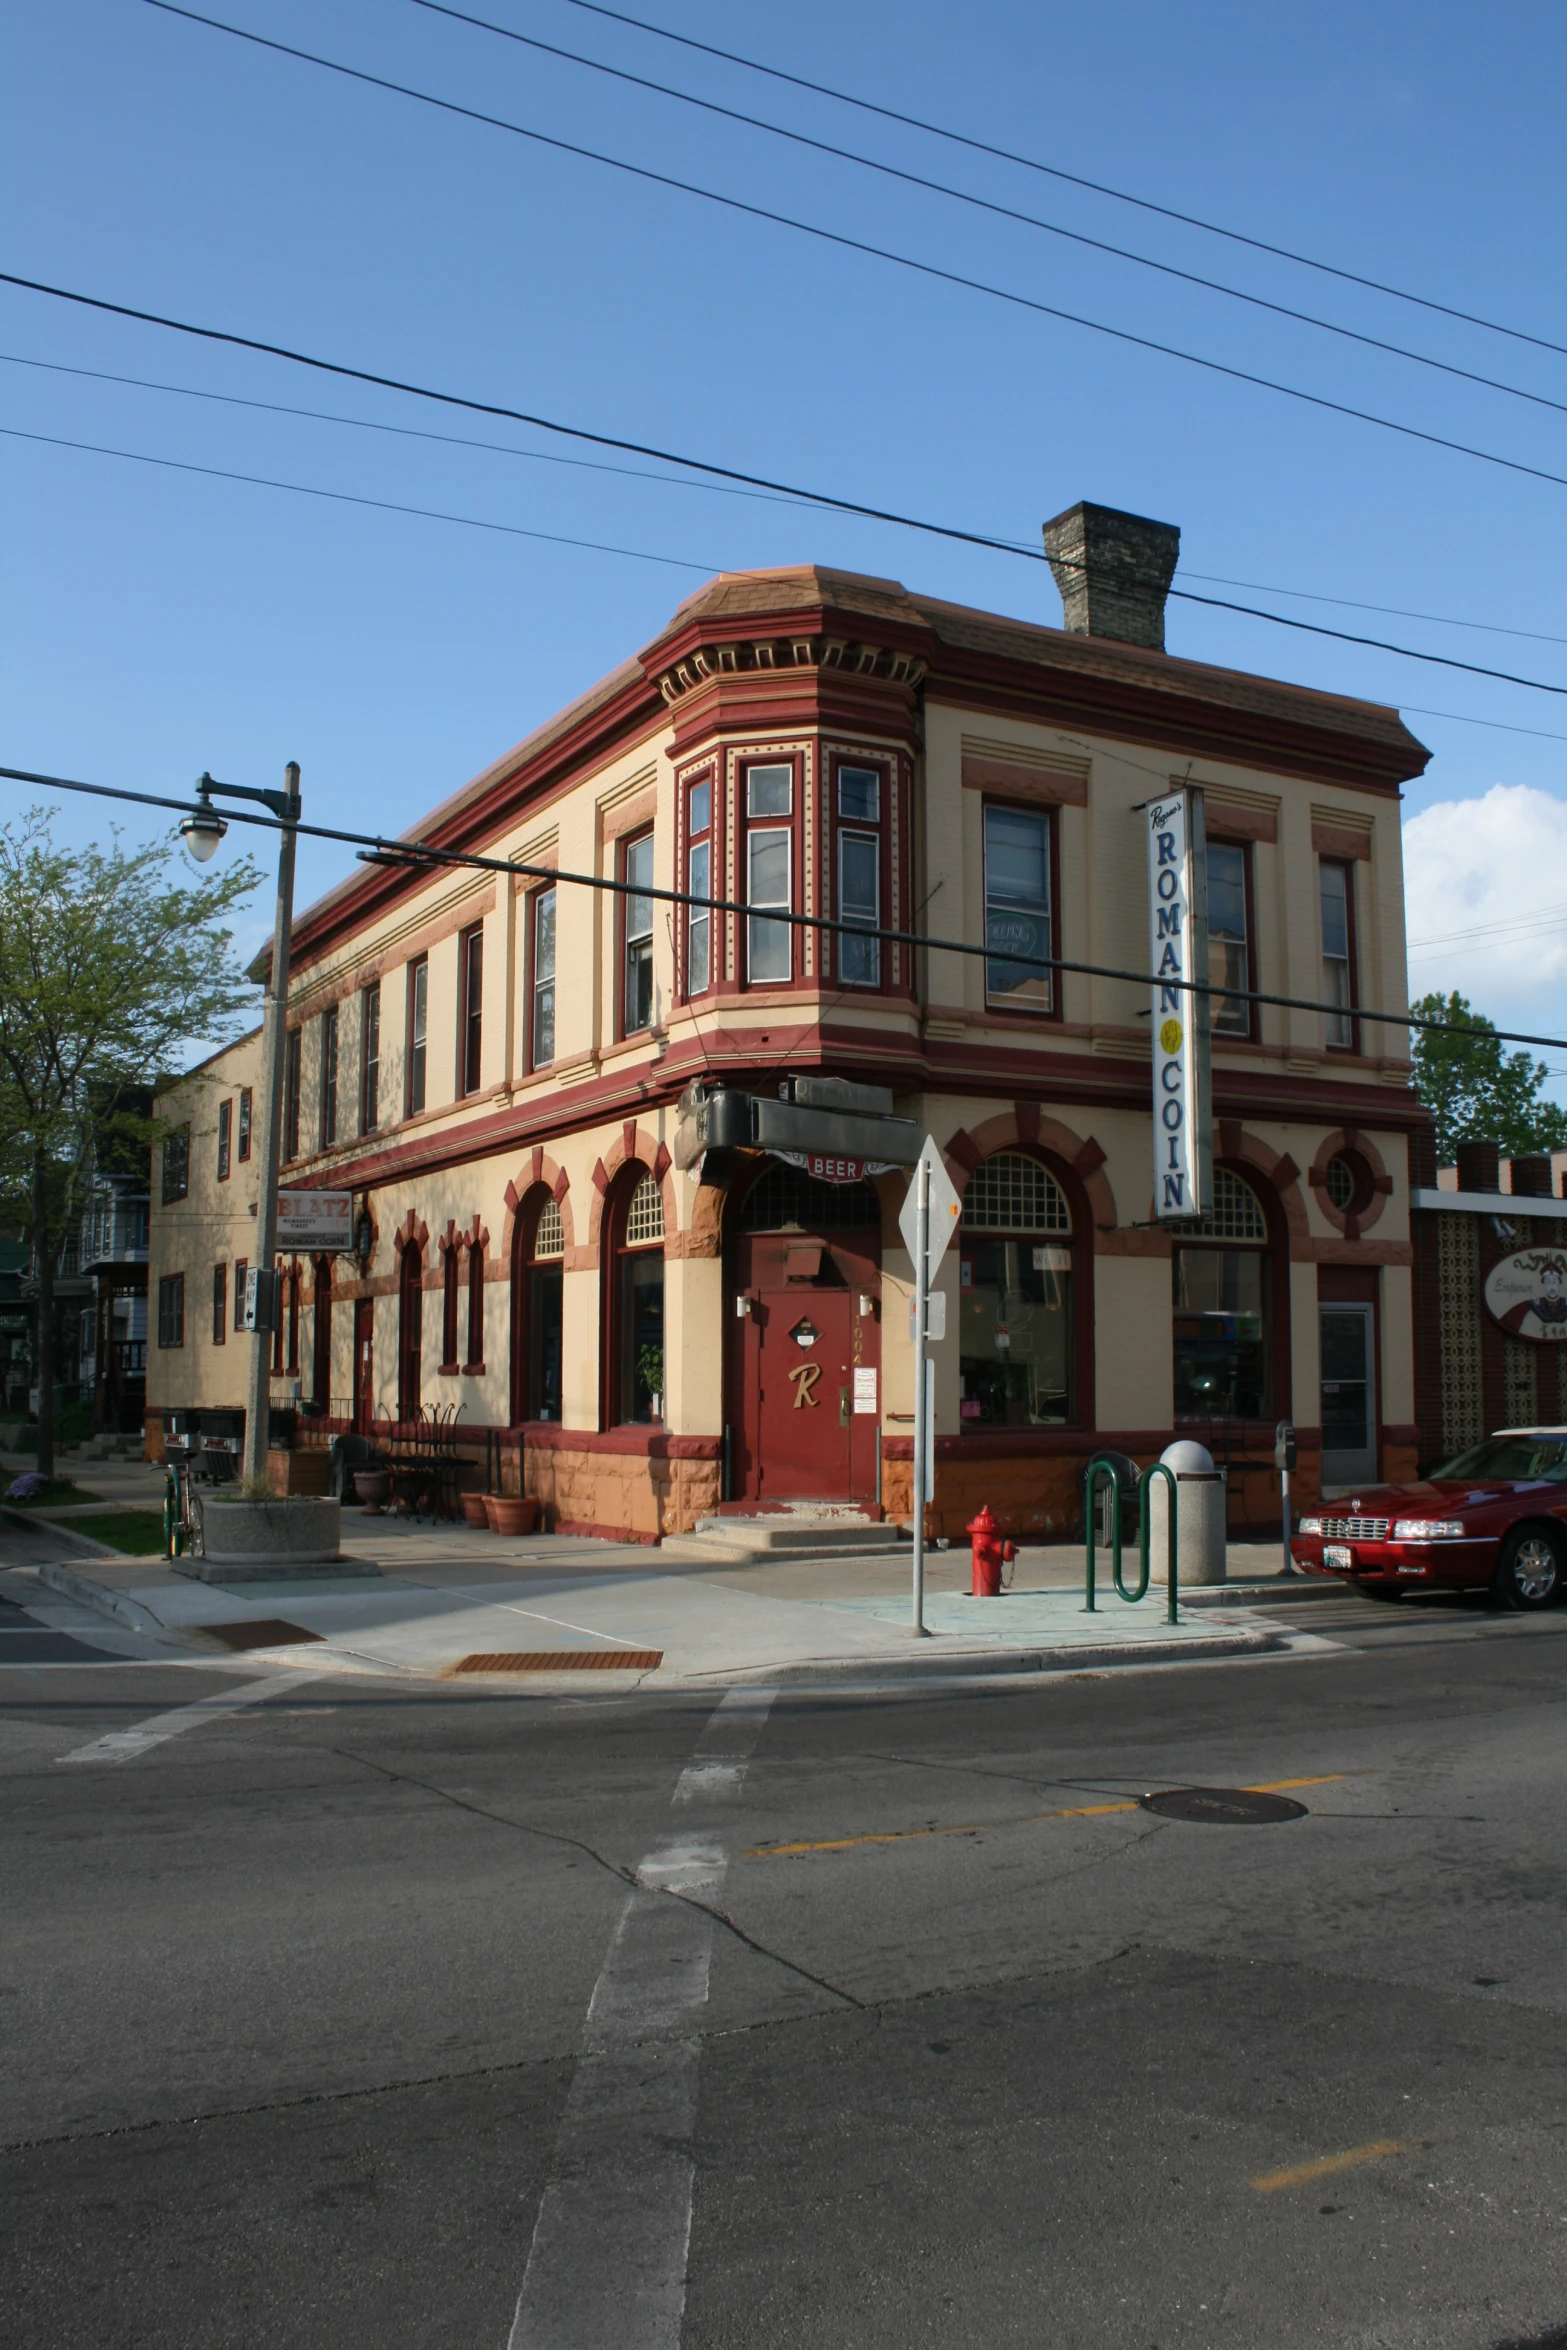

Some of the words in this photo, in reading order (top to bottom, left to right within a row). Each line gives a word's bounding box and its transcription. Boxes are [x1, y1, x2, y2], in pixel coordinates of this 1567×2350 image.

[1156, 831, 1181, 1013] ROMAN
[1161, 1060, 1185, 1208] COIN
[814, 1157, 857, 1178] BEER
[277, 1198, 350, 1217] BLATZ
[281, 1235, 316, 1246] ROMAN
[319, 1235, 345, 1246] COIN
[247, 1271, 256, 1287] ONE
[246, 1289, 256, 1304] WAY
[788, 1363, 821, 1408] R
